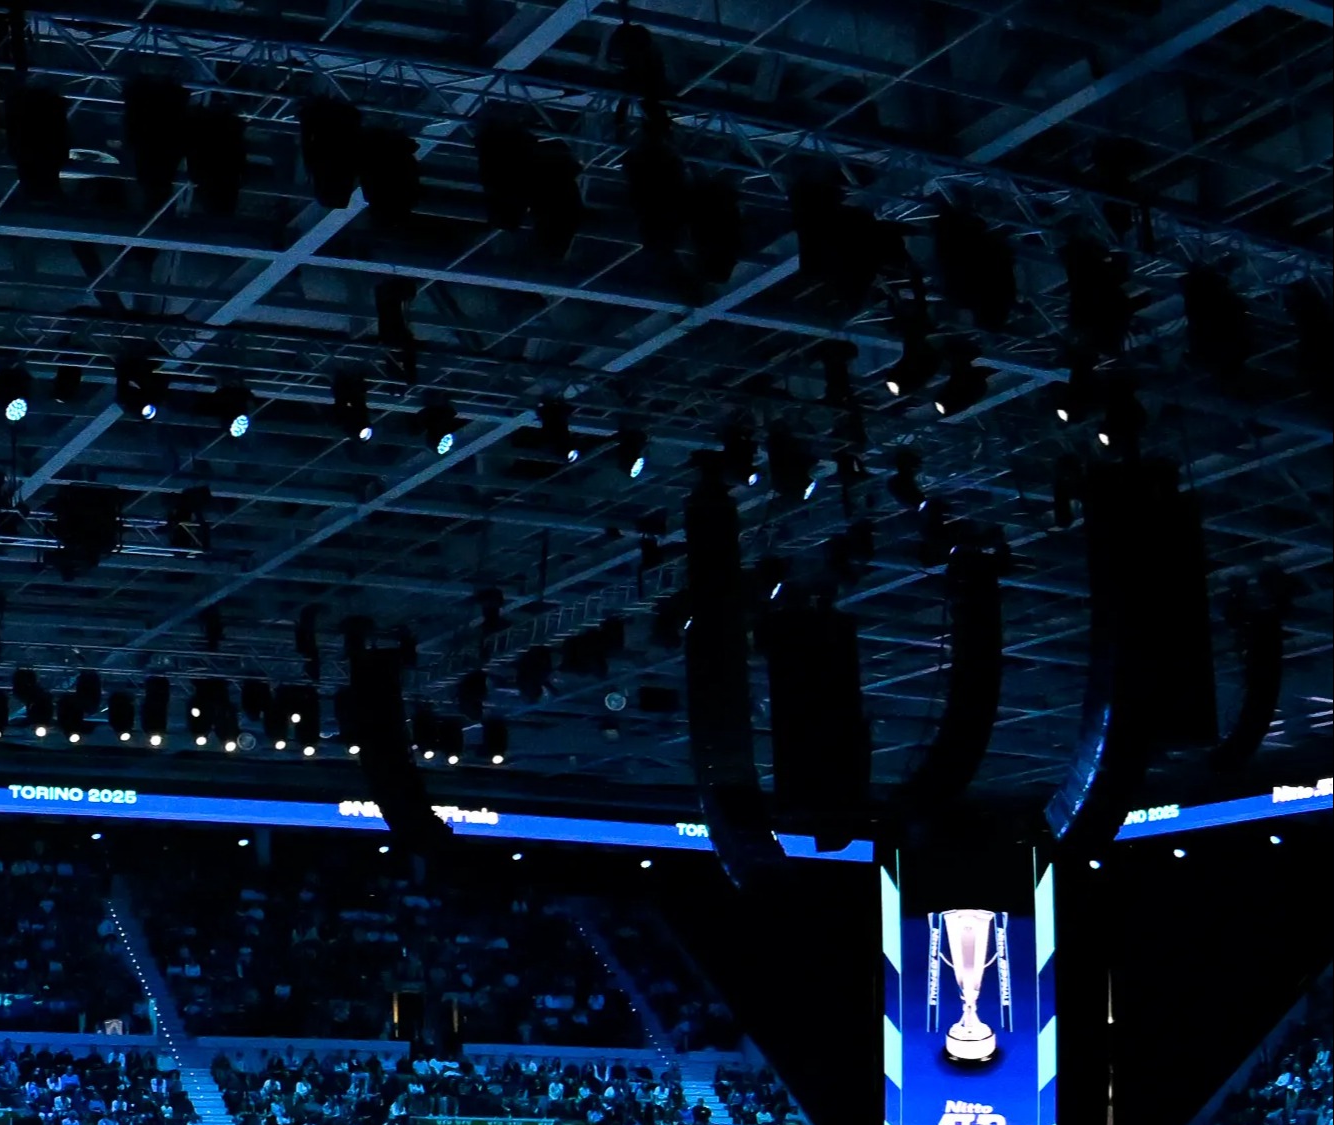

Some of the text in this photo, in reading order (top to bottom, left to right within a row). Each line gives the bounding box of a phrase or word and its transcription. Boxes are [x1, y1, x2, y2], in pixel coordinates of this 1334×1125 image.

[8, 784, 137, 804] TORINO 2025
[944, 1100, 994, 1114] Nitto
